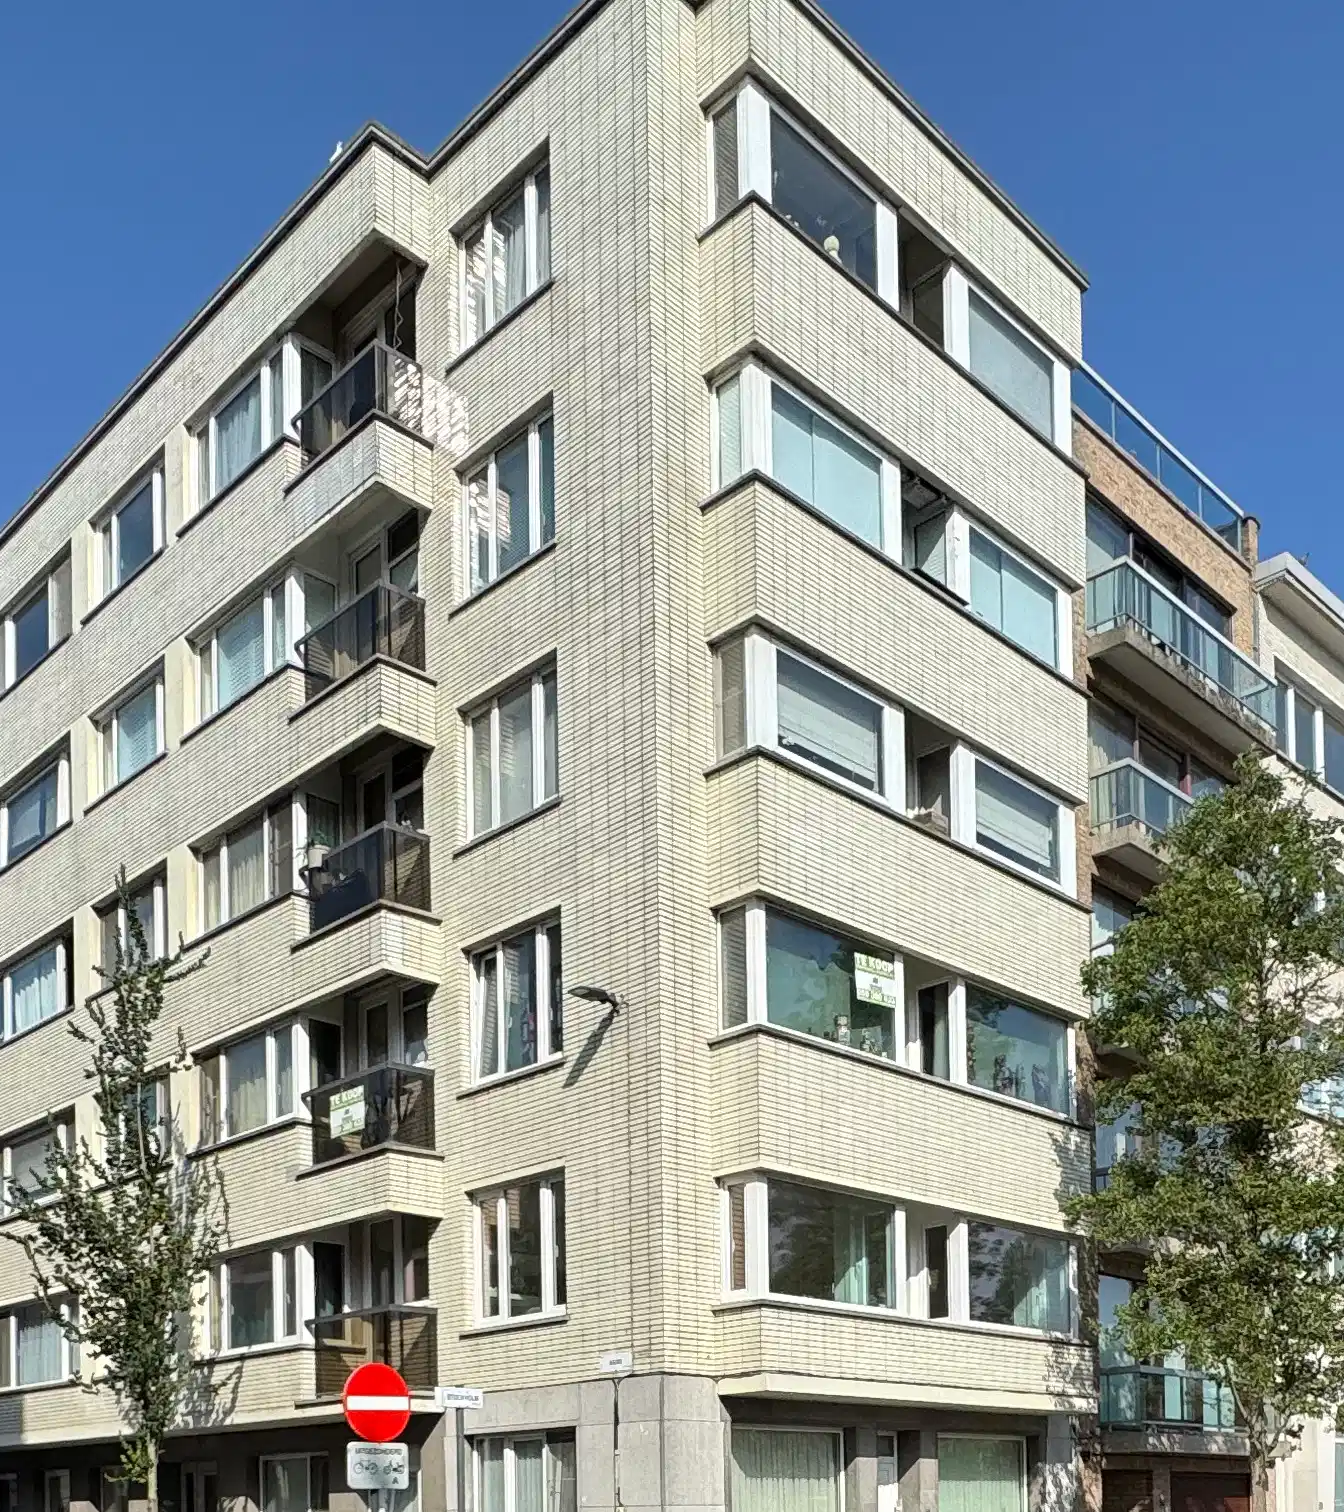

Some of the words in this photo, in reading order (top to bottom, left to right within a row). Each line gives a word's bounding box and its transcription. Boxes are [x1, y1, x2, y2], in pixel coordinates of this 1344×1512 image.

[856, 954, 867, 968] TE
[868, 956, 894, 973] KOOP
[392, 1476, 399, 1484] A
